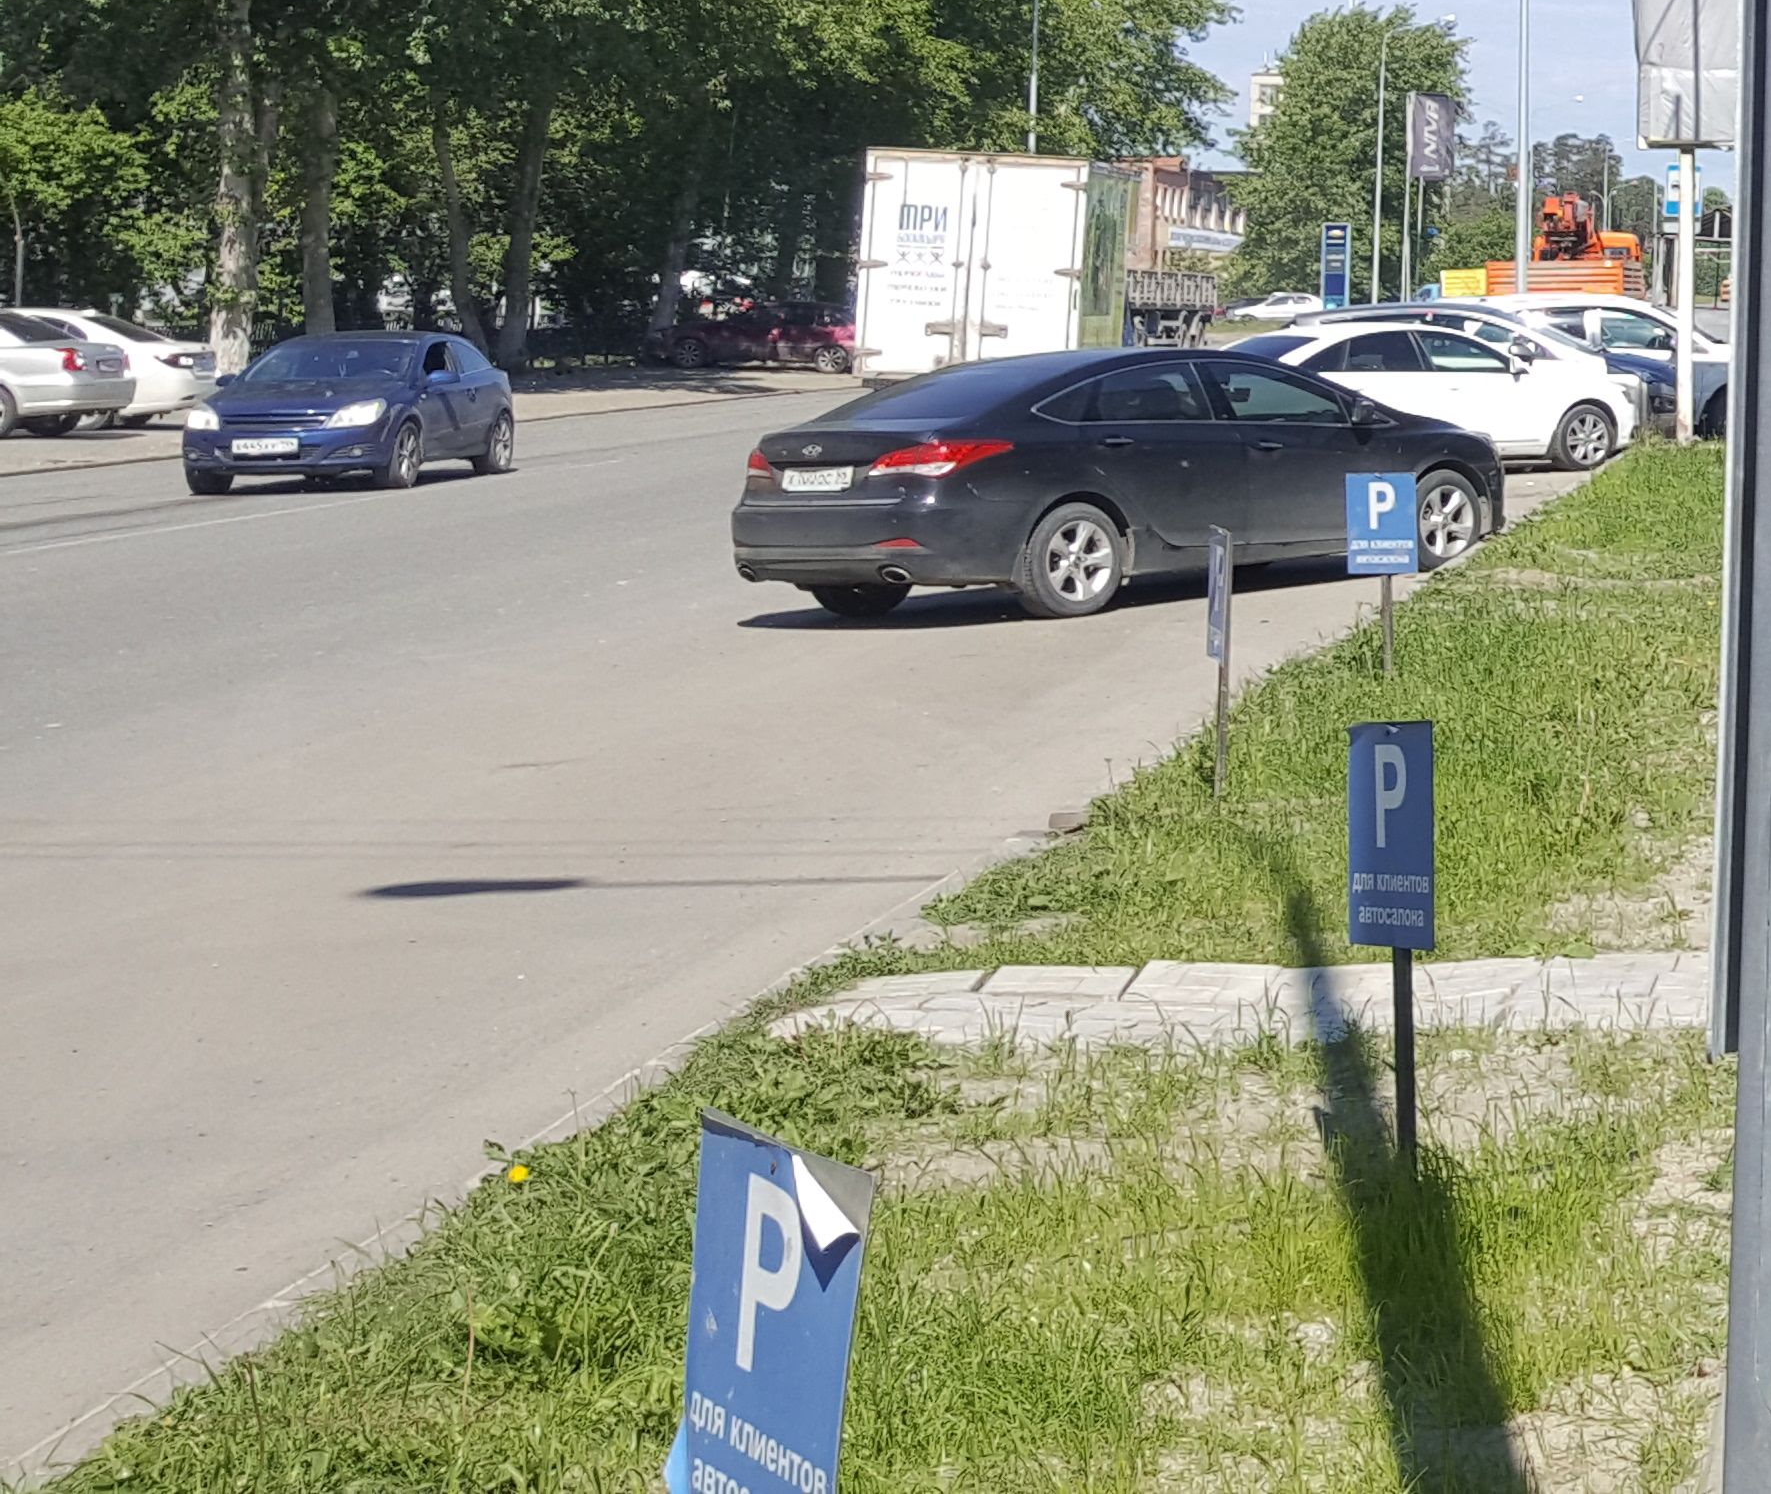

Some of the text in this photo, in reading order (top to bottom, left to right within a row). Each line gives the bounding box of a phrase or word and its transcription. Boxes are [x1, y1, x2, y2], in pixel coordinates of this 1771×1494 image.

[1374, 744, 1407, 848] P
[1352, 873, 1430, 894] для клиентов
[1358, 906, 1425, 927] автосалона
[736, 1172, 802, 1373] P
[689, 1390, 828, 1494] для клиентов
